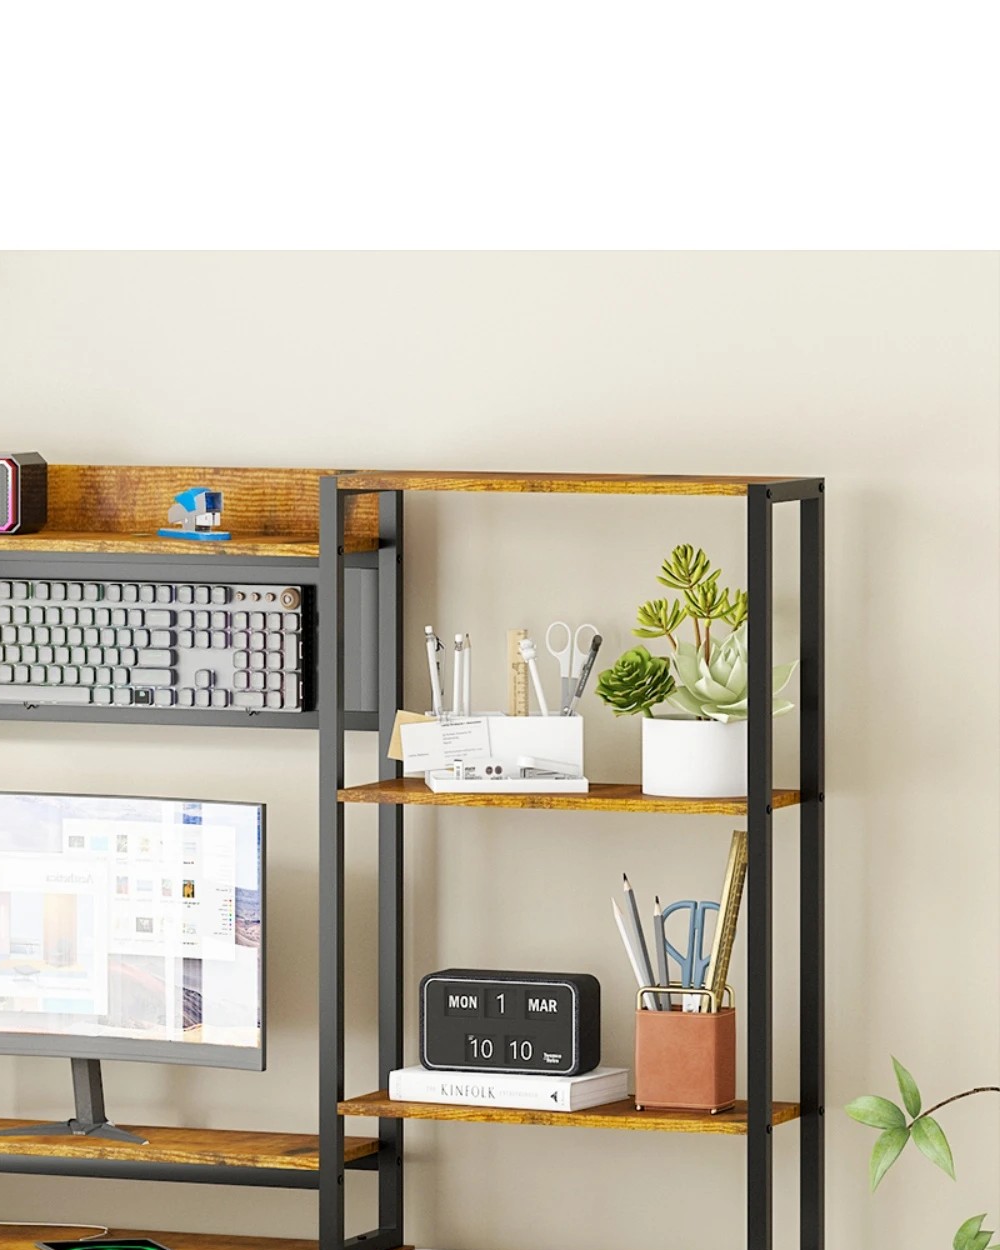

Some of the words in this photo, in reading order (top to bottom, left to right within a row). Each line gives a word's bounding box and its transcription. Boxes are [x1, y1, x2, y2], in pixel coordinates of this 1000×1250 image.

[449, 995, 477, 1009] MON
[497, 994, 505, 1014] 1
[528, 999, 558, 1013] MAR
[470, 1039, 493, 1059] 10
[509, 1041, 533, 1061] 10
[441, 1083, 496, 1100] KINFOLK
